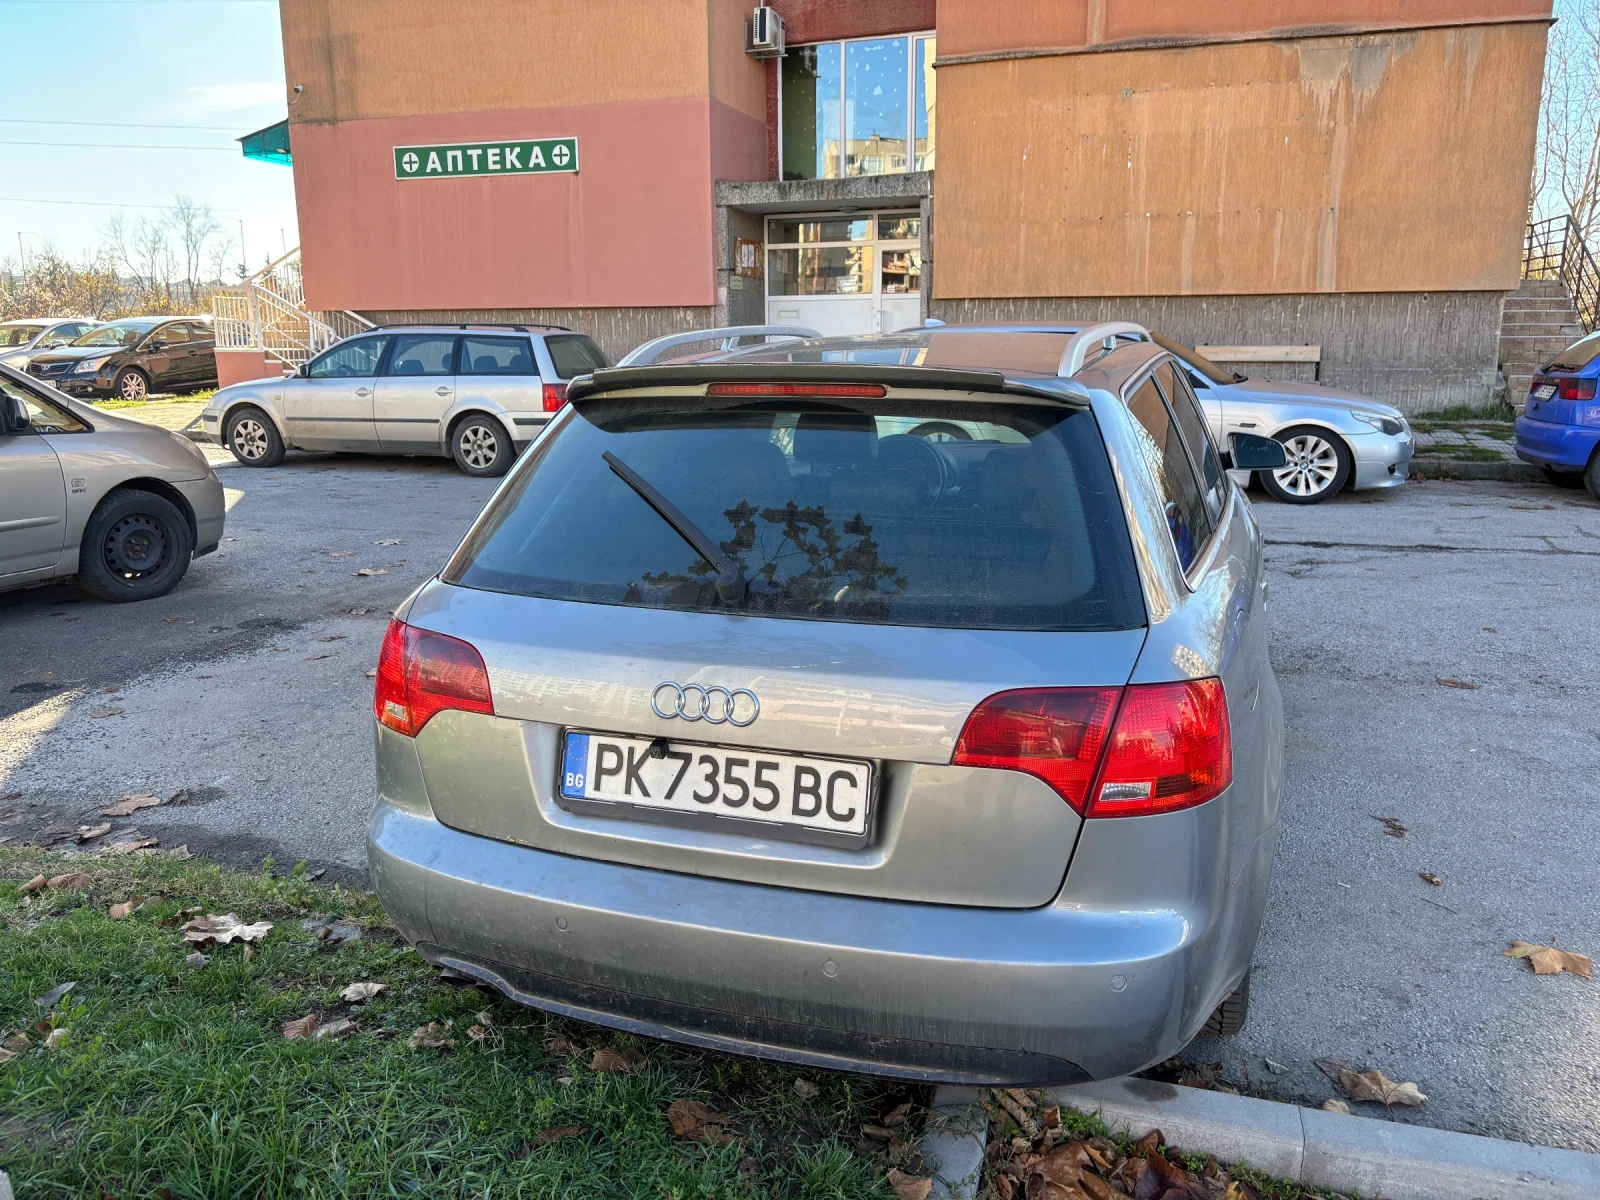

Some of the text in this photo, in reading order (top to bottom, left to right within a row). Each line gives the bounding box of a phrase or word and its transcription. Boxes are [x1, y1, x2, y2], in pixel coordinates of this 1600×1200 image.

[425, 145, 547, 173] АПТЕКА
[565, 772, 584, 788] BG
[593, 743, 858, 823] PK 7355 BC
